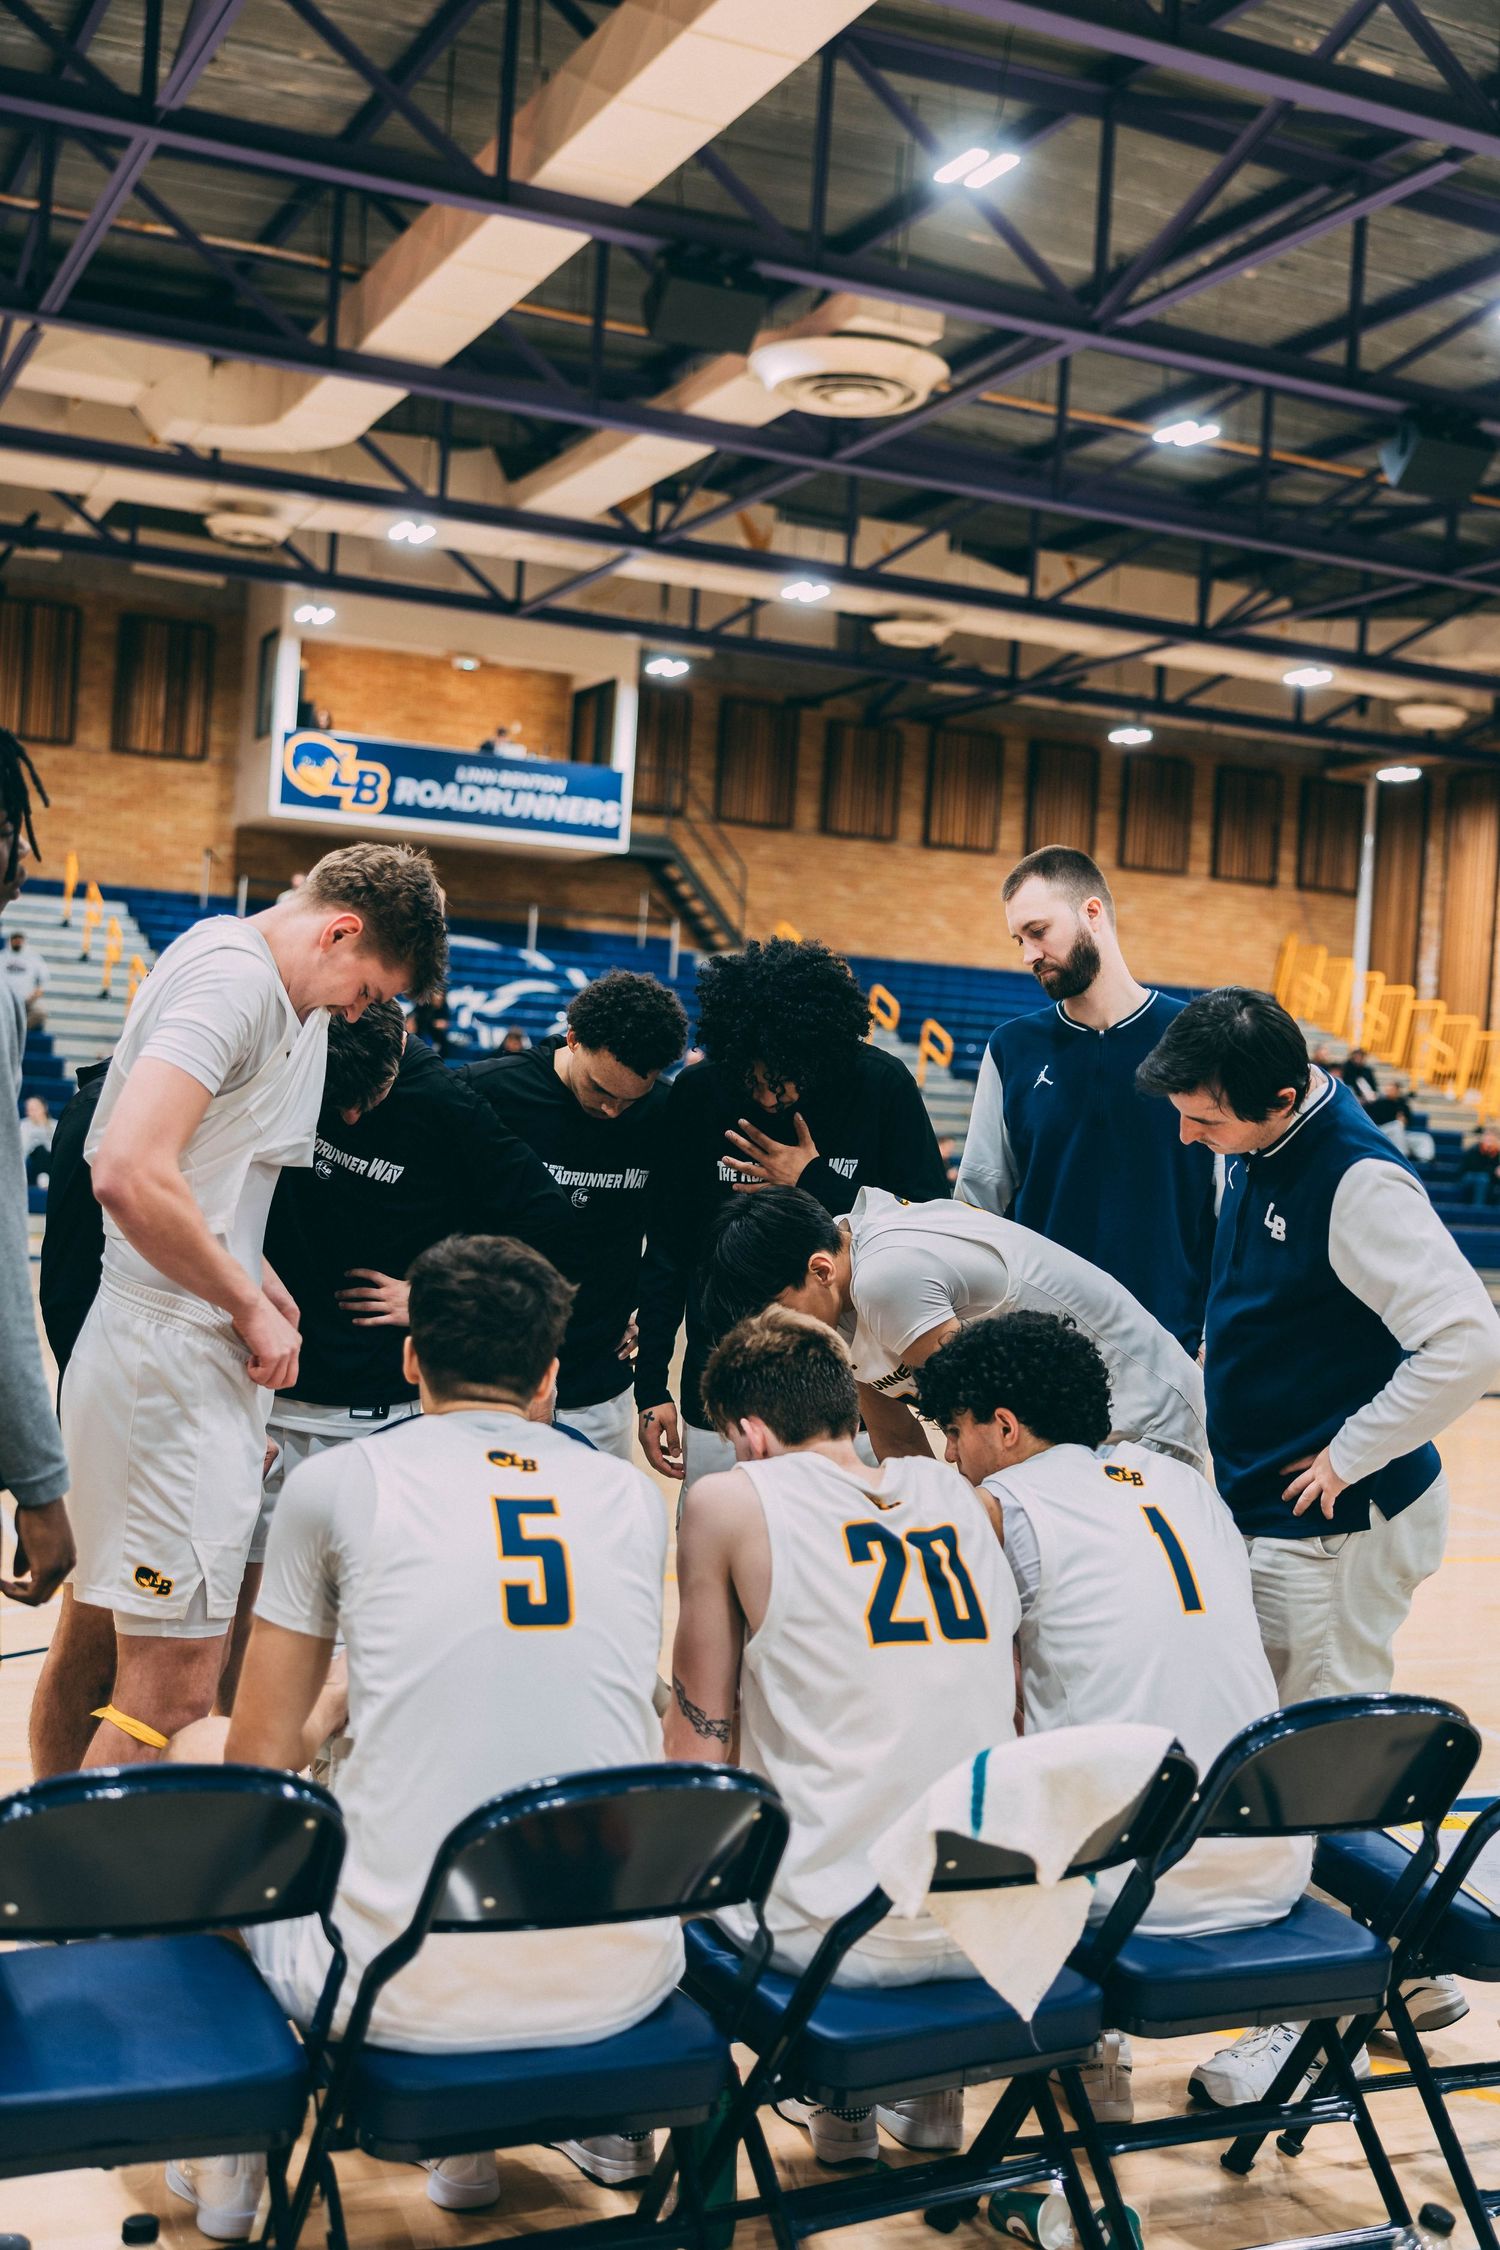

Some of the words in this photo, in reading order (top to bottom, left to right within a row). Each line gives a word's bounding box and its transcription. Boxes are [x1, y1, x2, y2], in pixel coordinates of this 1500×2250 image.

[393, 776, 622, 829] ROADRUNNERS
[313, 1137, 369, 1176] DRUNNER
[367, 1157, 403, 1184] WAY
[542, 1161, 623, 1189] ADRUNNER
[622, 1168, 649, 1189] WAY
[828, 1157, 857, 1179] WAY
[1264, 1202, 1286, 1242] LB
[490, 1495, 577, 1631] 5
[841, 1517, 990, 1649] 20
[1140, 1503, 1206, 1614] 1
